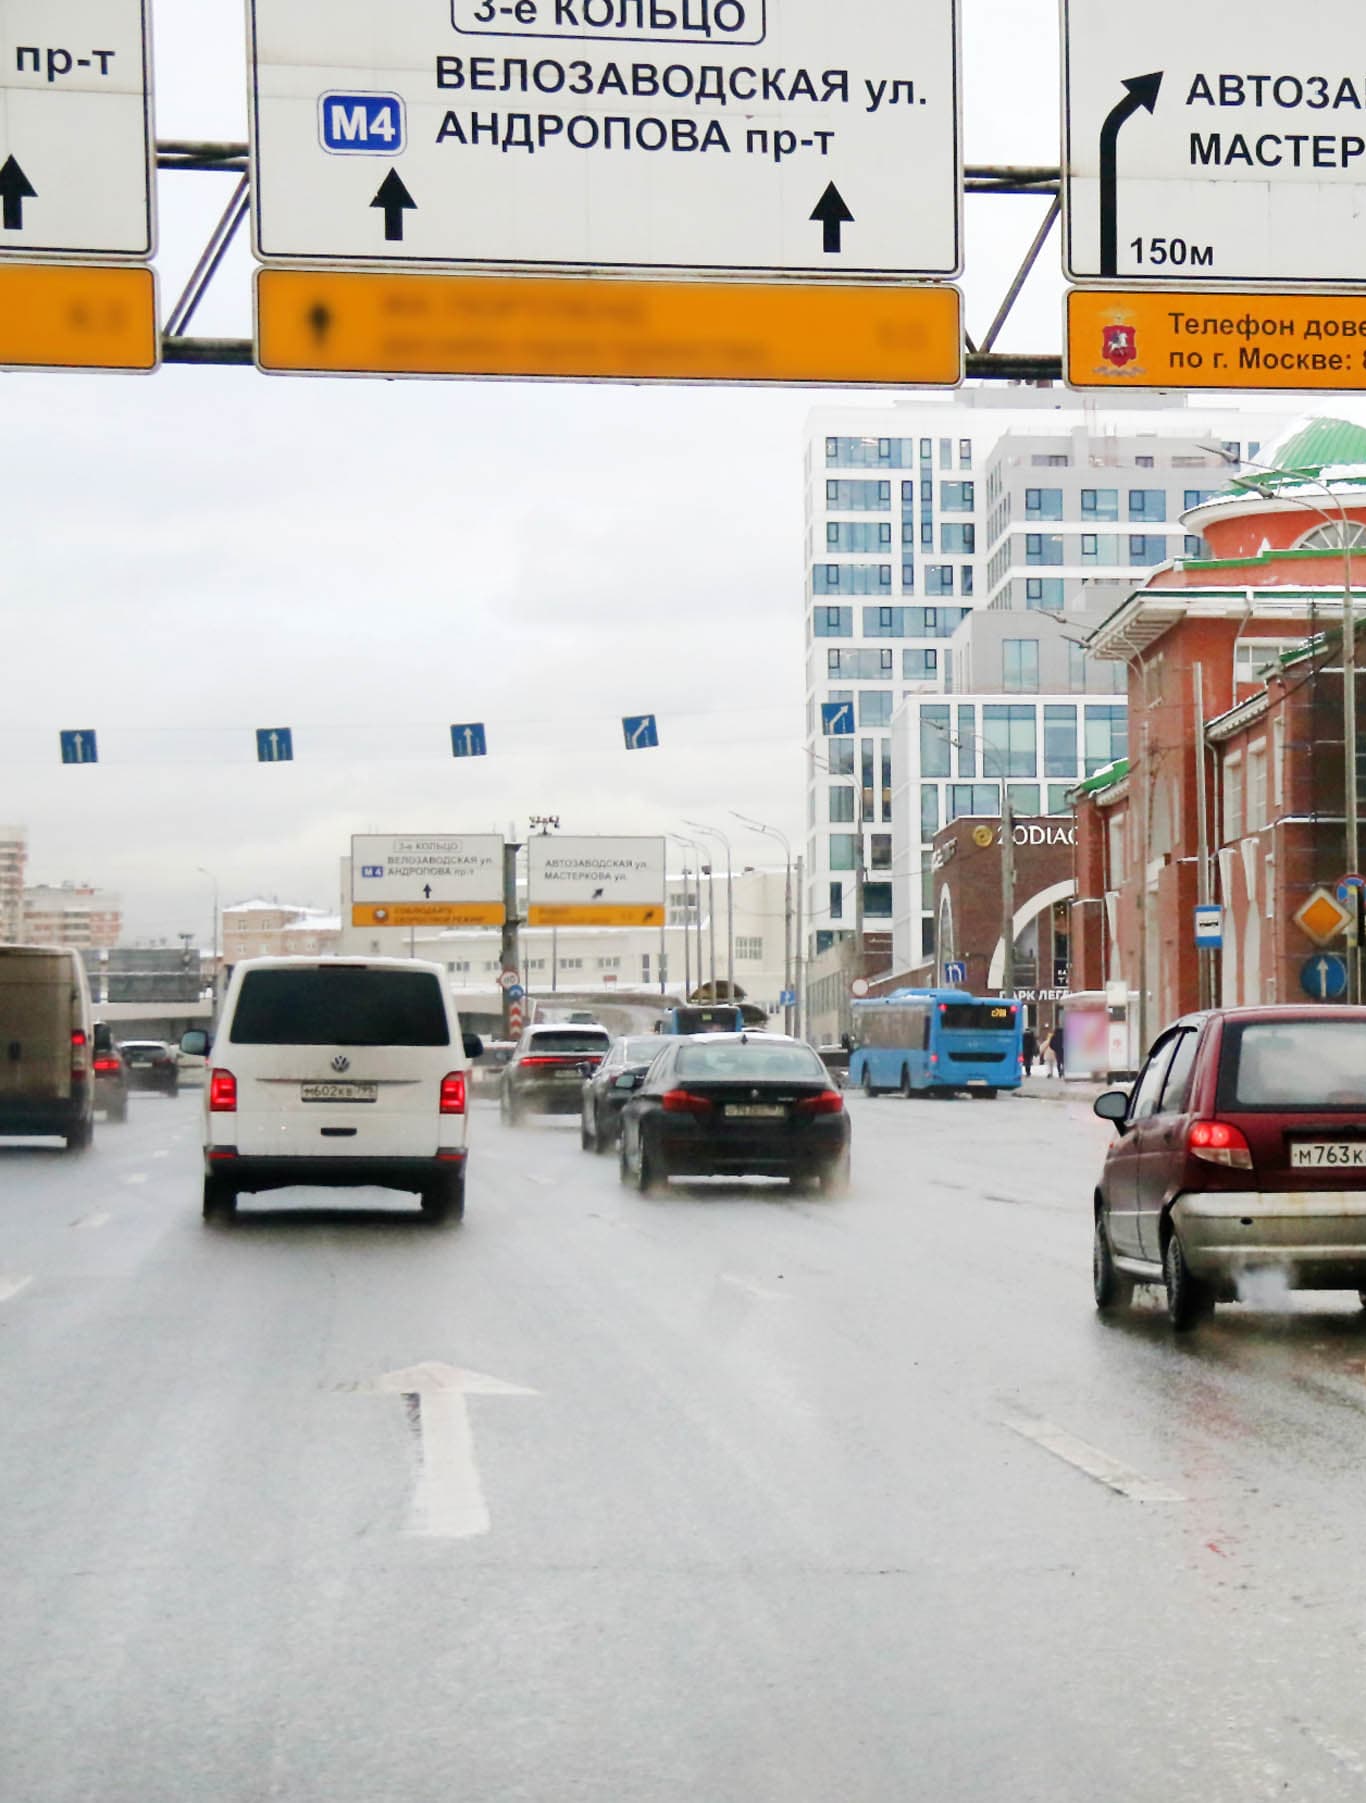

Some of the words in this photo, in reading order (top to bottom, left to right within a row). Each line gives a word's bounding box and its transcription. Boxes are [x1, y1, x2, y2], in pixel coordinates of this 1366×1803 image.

[551, 0, 746, 41] КОЛЬЦО
[16, 46, 115, 83] пр-т
[436, 55, 849, 106] ВЕЛОЗАВОДСКАЯ
[864, 79, 927, 113] ул.
[331, 105, 396, 142] М4
[435, 110, 731, 154] АНДРОПОВА
[746, 129, 835, 163] пр-т
[1130, 237, 1213, 266] 150м
[1167, 312, 1295, 342] Телефон
[1169, 351, 1203, 369] по
[1213, 352, 1228, 369] г.
[1239, 347, 1351, 371] Москве:
[997, 825, 1079, 845] ODIA
[387, 856, 479, 866] ВЕЛОЗАВОДСКАЯ
[387, 867, 452, 877] АНДРОПОВА
[544, 859, 633, 869] АВТОЗАВОДСКАЯ
[544, 871, 612, 881] МАСТЕРКОВА
